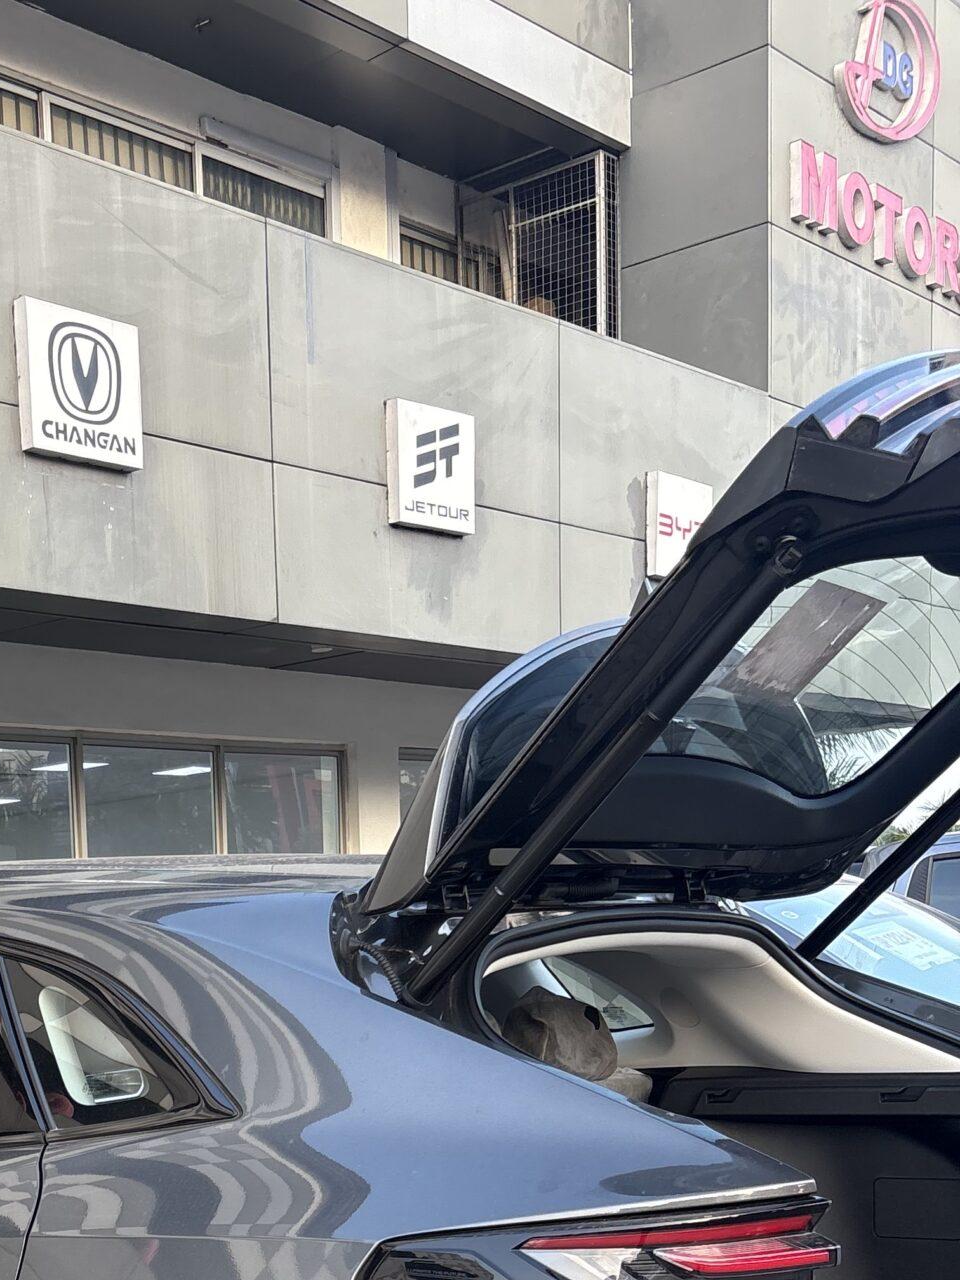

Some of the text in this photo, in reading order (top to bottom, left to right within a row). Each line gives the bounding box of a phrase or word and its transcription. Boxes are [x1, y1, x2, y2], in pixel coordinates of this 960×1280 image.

[790, 138, 960, 300] MOTOR
[41, 419, 137, 456] CHANGAN
[404, 499, 470, 522] JETOUR
